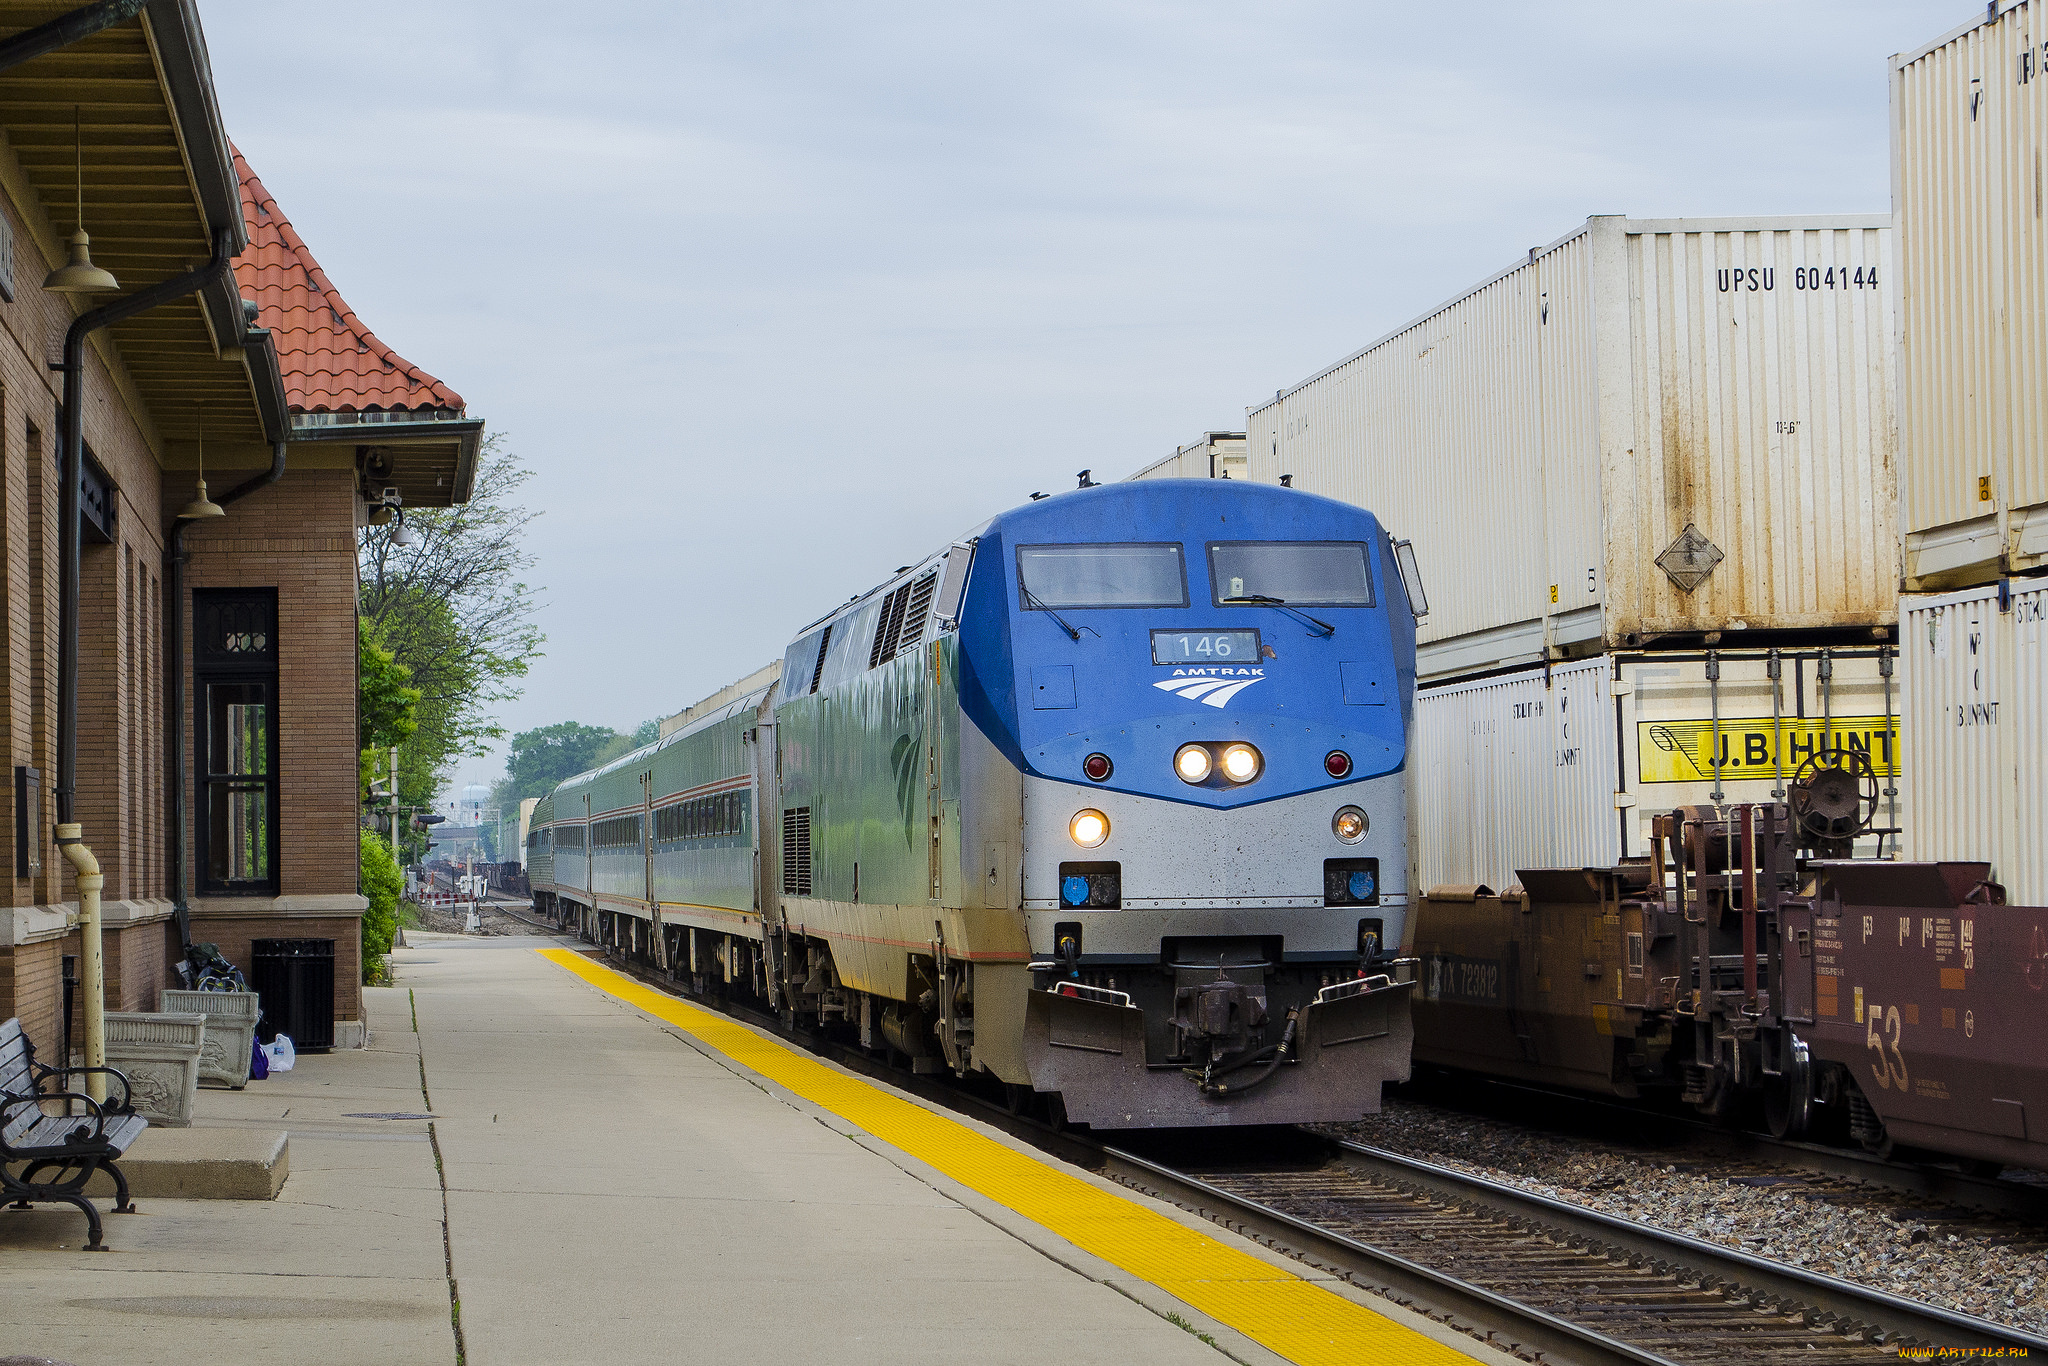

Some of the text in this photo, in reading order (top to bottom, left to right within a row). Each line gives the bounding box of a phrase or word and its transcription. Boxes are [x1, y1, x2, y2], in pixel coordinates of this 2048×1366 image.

[1718, 266, 1878, 293] UPSU 604144
[1179, 636, 1232, 657] 146
[1172, 668, 1265, 676] AMTRAK
[1708, 730, 1896, 769] J.B. HUNT
[1461, 963, 1497, 998] 723812
[1867, 1004, 1909, 1092] 53
